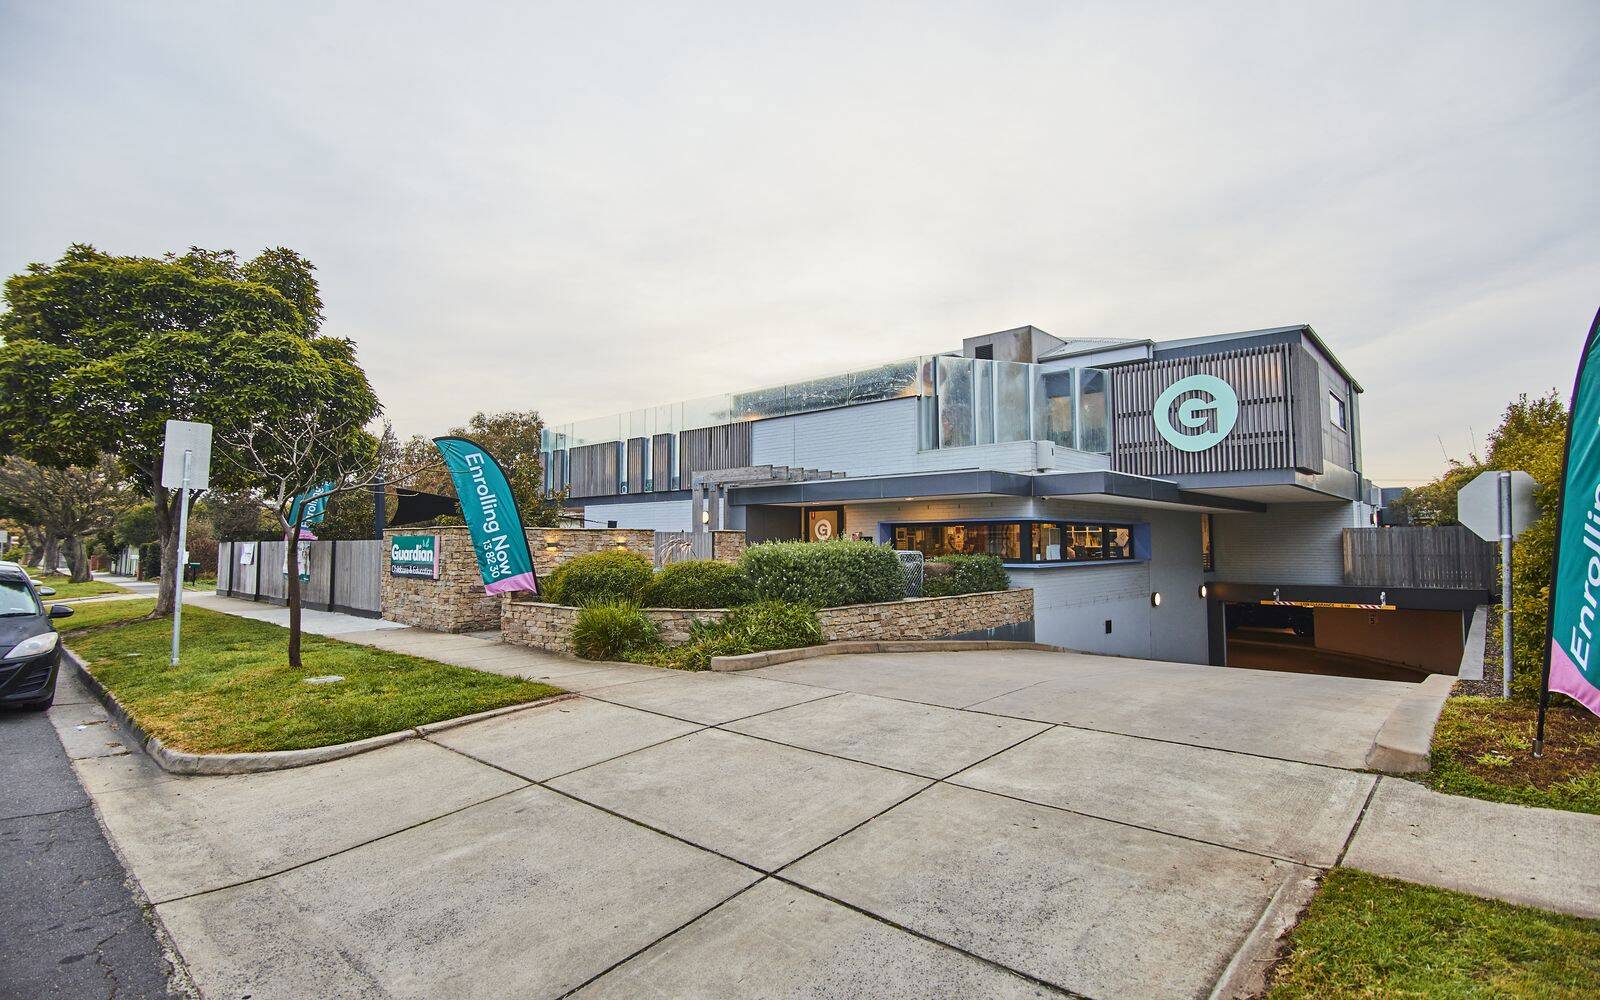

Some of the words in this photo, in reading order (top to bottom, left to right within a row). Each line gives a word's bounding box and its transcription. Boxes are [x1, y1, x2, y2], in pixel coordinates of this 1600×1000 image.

[1168, 389, 1218, 437] G
[300, 485, 324, 528] Enrollng
[465, 452, 500, 533] Enrolling
[491, 534, 512, 574] Now
[817, 523, 828, 537] G
[483, 539, 493, 550] 13
[391, 544, 434, 562] Guardian
[485, 551, 497, 564] 82
[490, 564, 500, 578] 30
